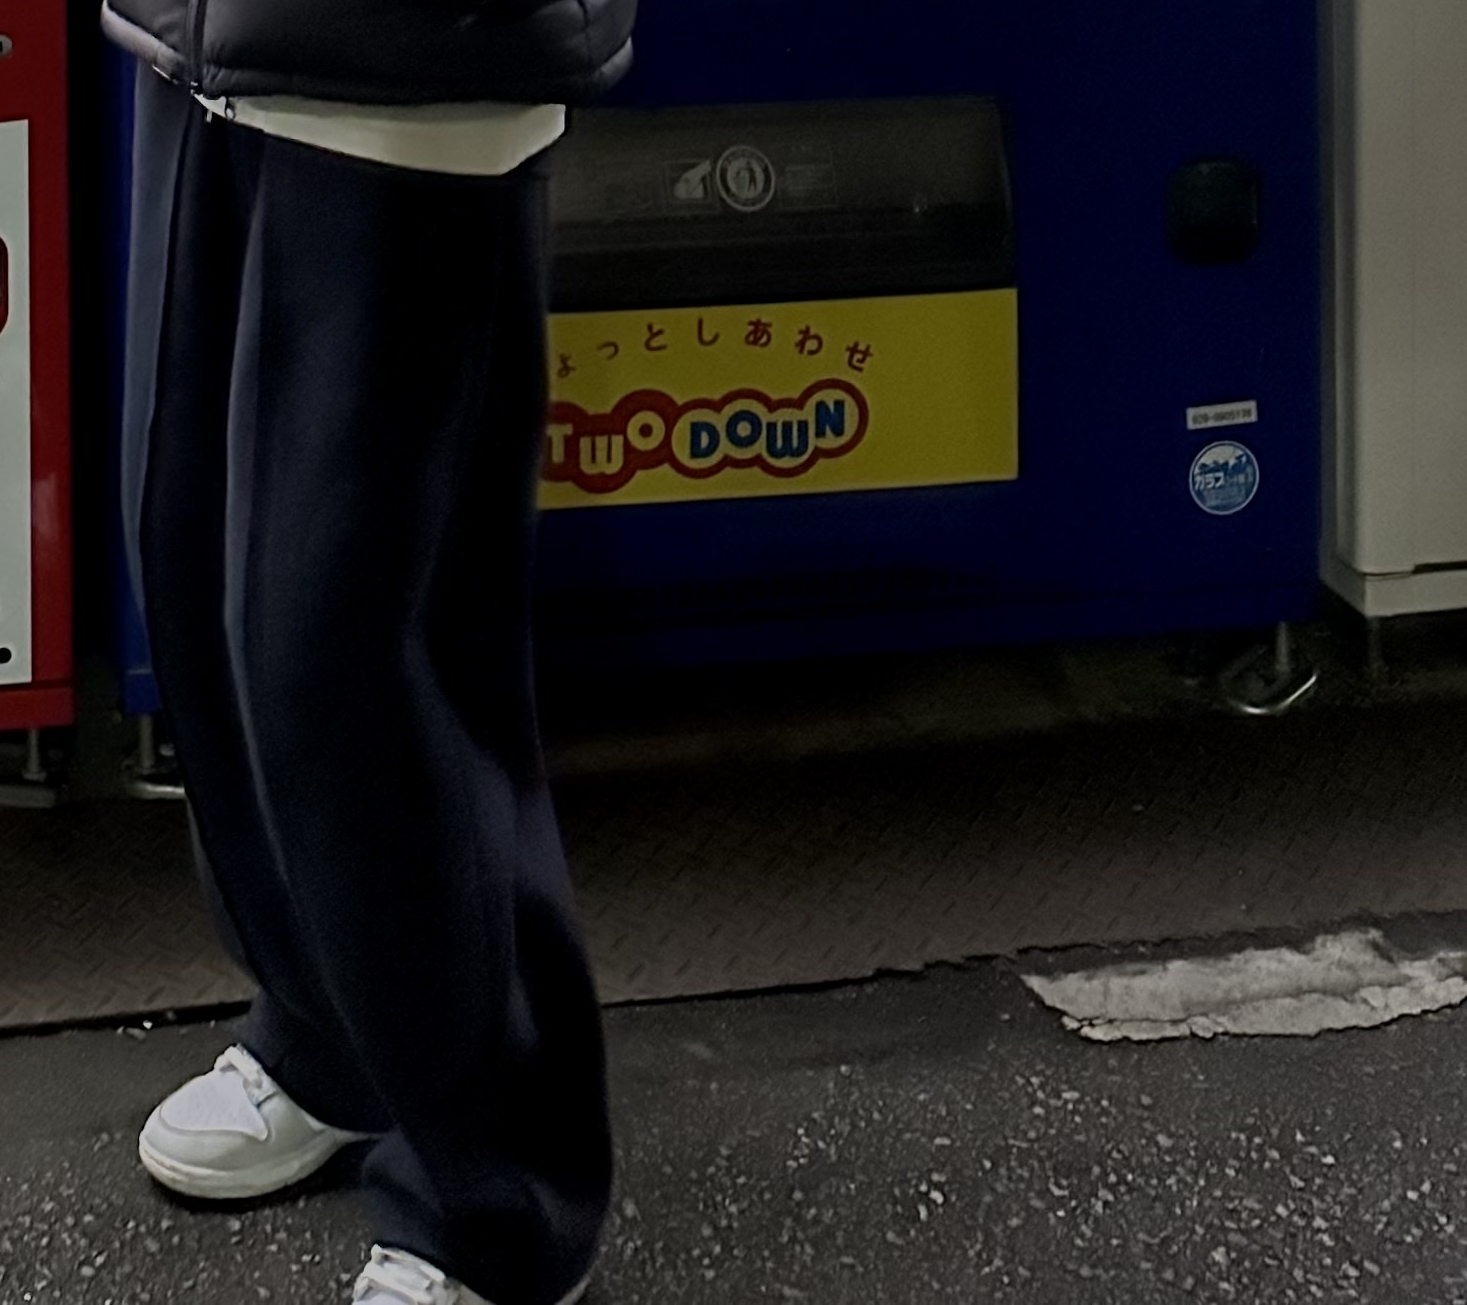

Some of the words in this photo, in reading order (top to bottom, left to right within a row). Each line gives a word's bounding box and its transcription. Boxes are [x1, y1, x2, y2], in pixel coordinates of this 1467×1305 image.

[555, 317, 874, 379] ょっとしあわせ
[546, 409, 666, 476] TWO
[689, 398, 846, 460] DOWN
